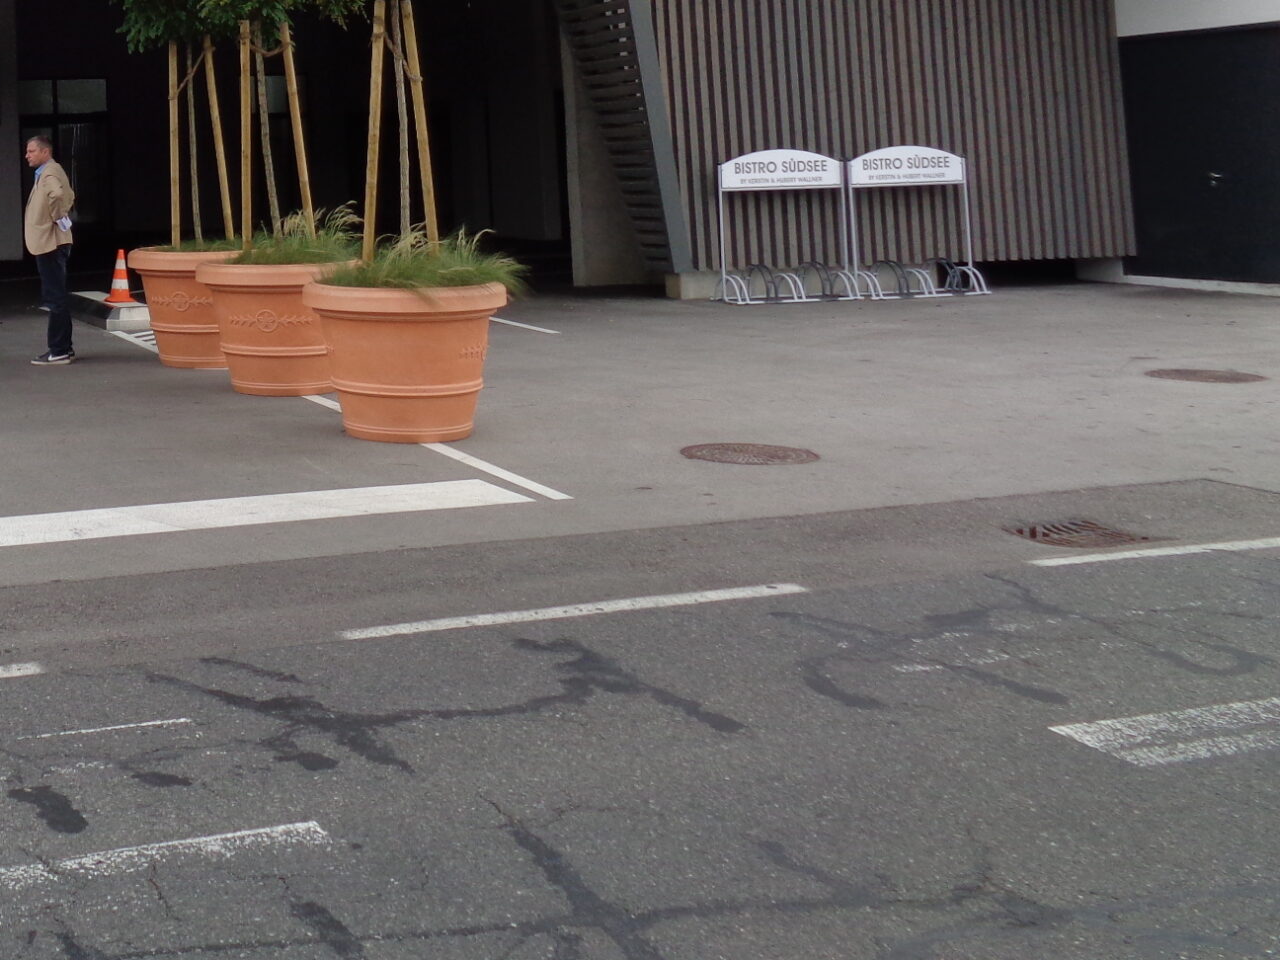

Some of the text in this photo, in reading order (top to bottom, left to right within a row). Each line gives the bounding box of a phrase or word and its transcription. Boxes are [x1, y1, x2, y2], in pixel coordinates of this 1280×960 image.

[734, 158, 827, 175] BISTRO SÜDSEE
[862, 154, 950, 171] BISTRO SÜDSEE
